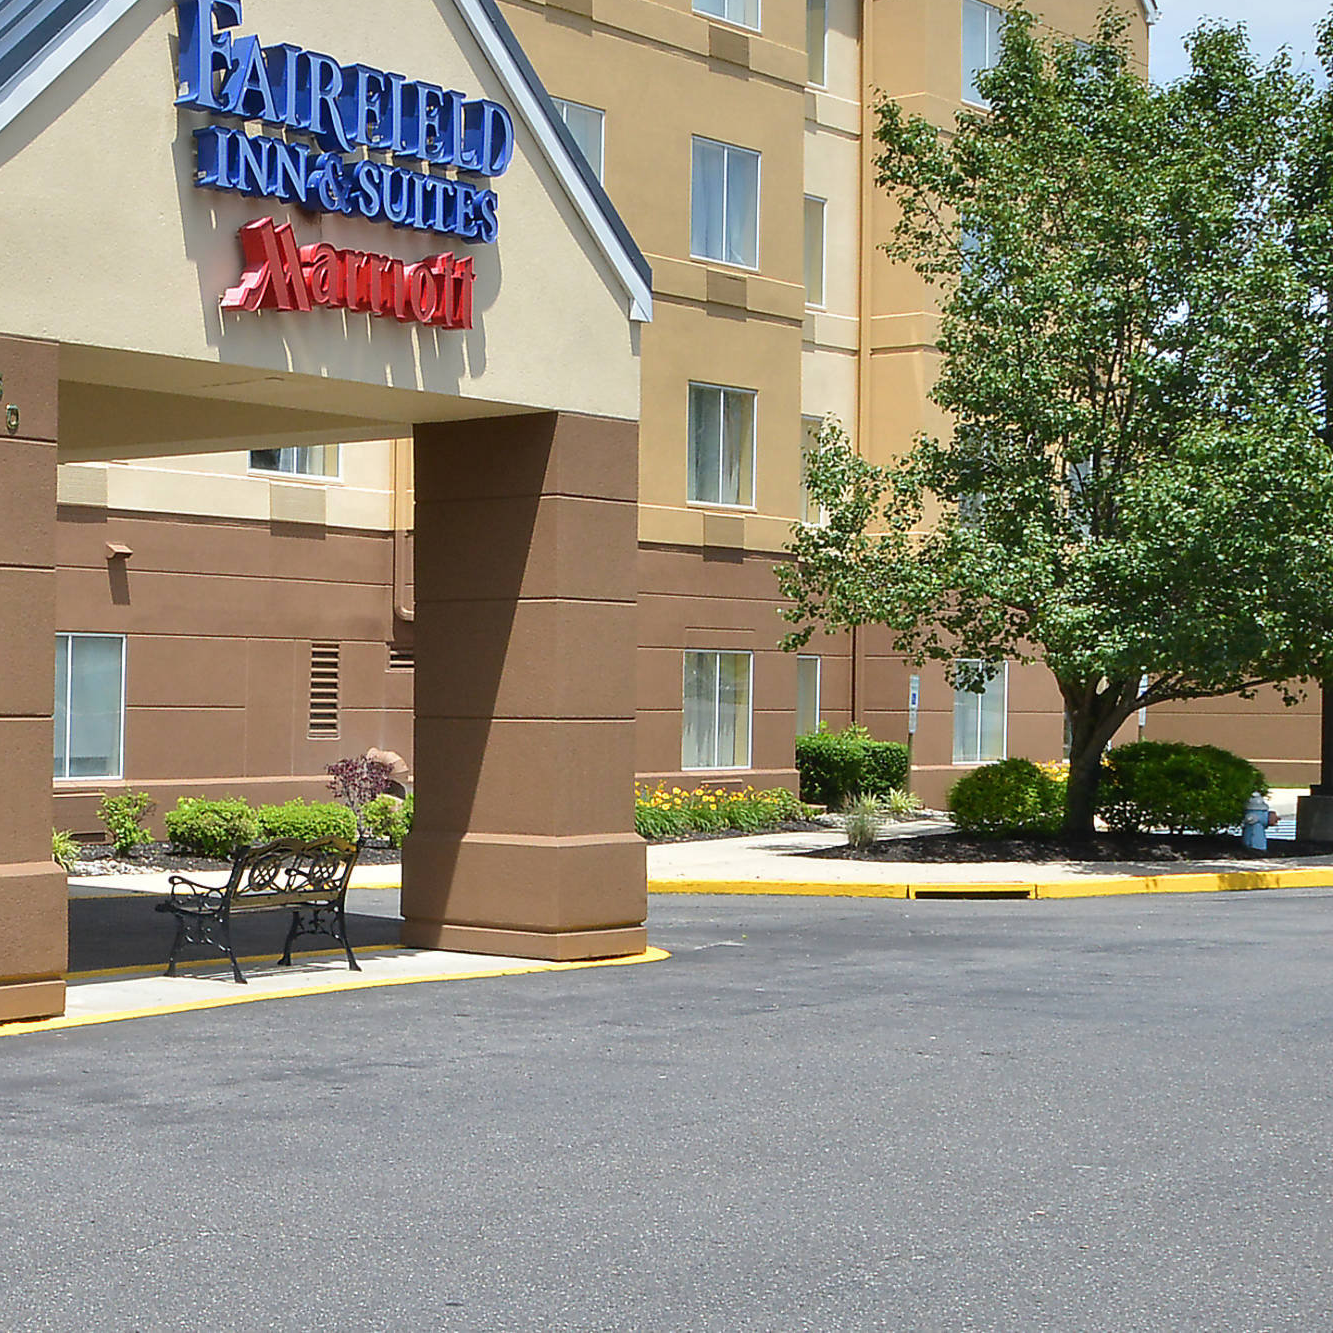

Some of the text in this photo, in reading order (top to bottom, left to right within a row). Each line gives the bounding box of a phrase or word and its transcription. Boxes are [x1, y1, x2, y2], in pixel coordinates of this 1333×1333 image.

[193, 125, 499, 244] INN & SUITES
[220, 216, 477, 330] Marriott
